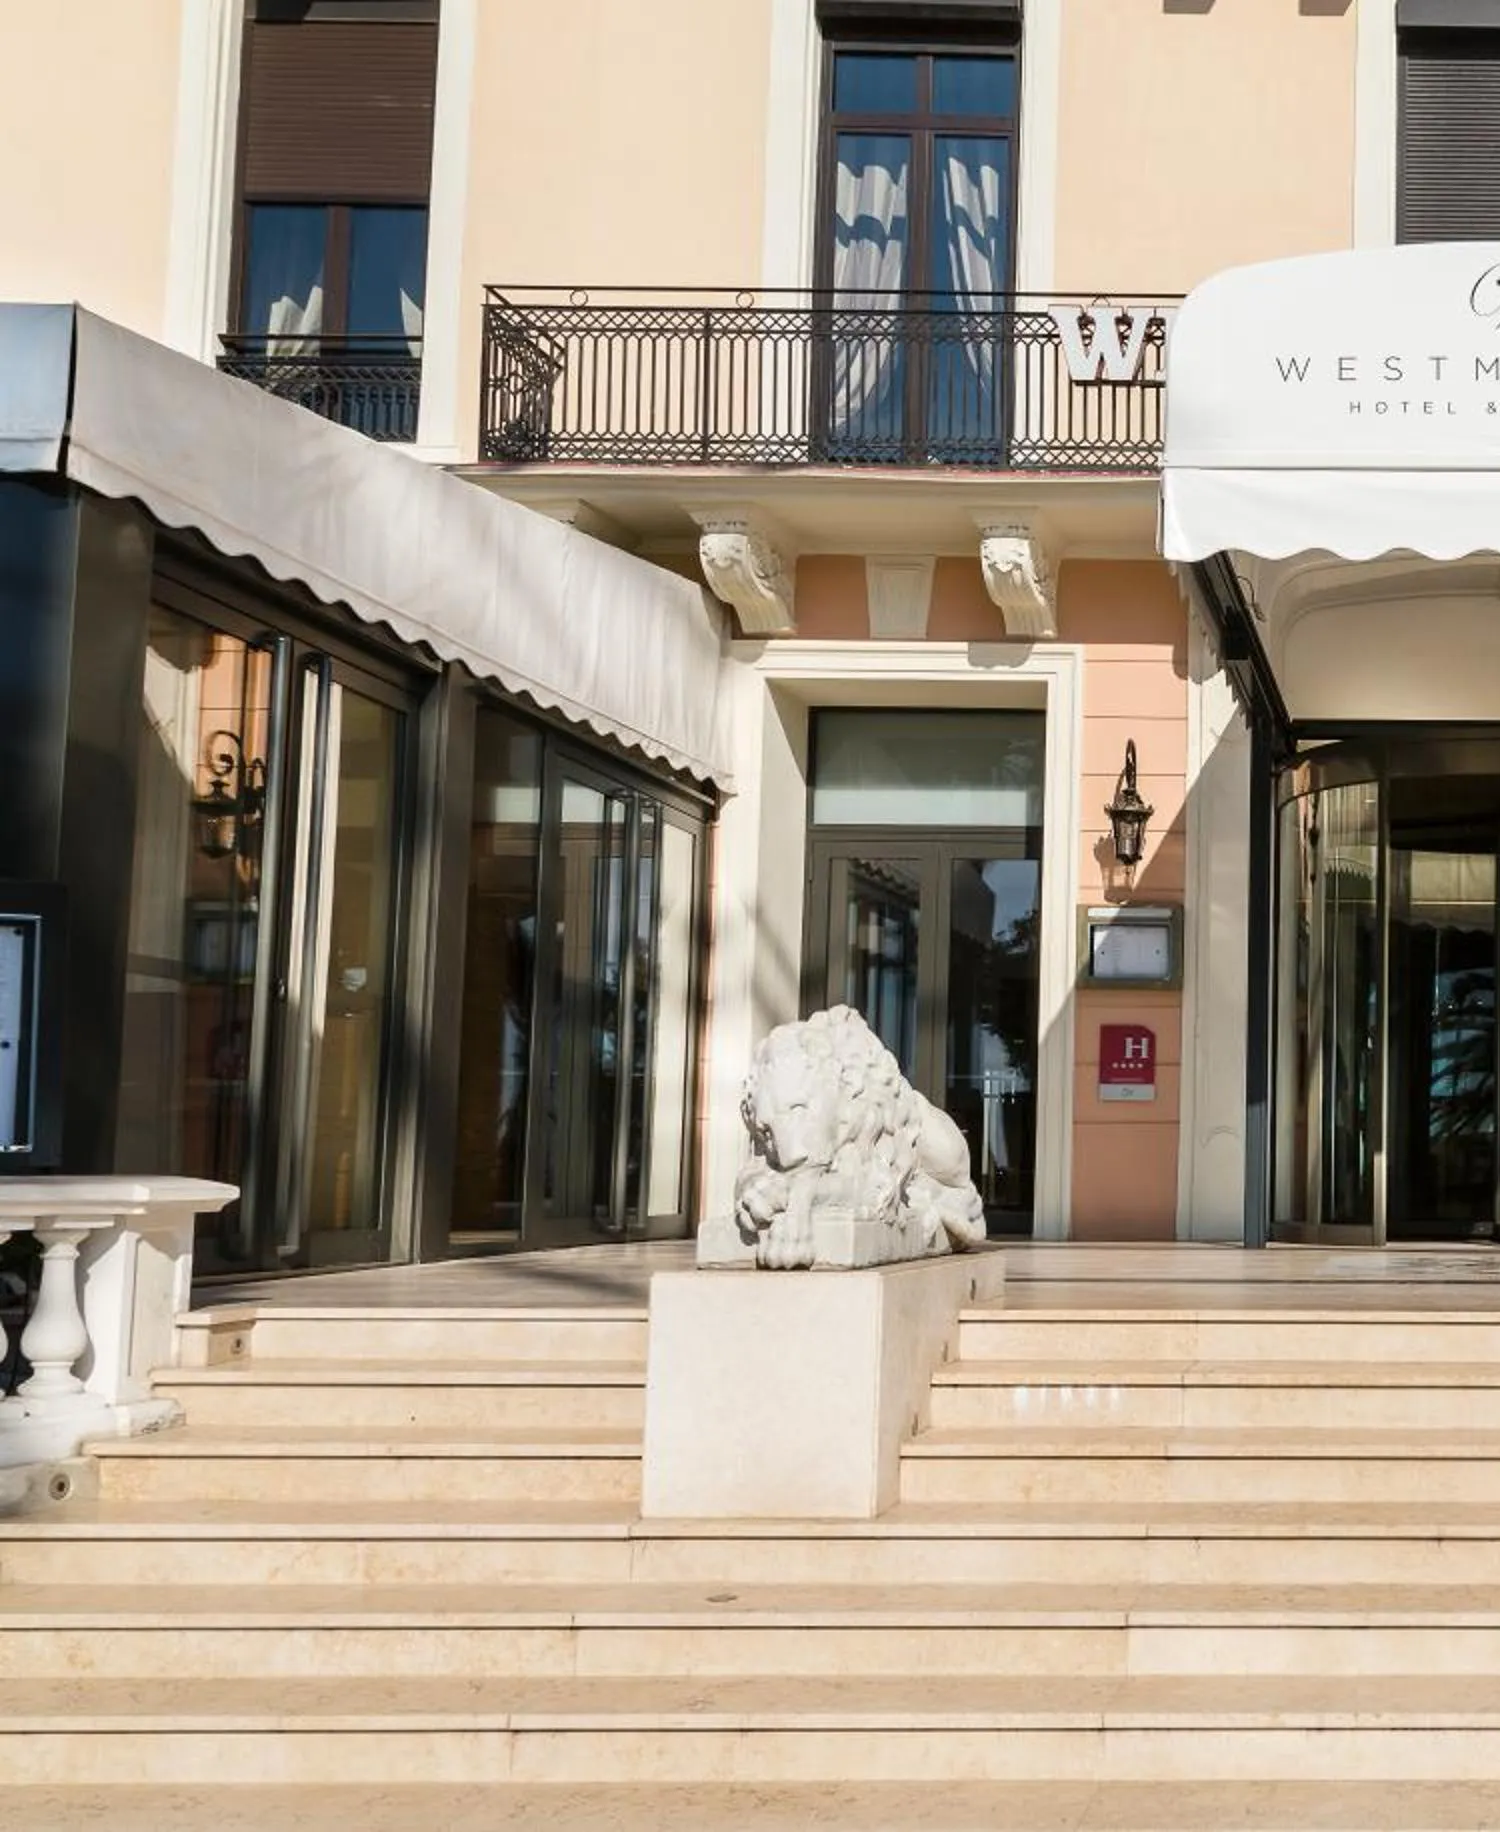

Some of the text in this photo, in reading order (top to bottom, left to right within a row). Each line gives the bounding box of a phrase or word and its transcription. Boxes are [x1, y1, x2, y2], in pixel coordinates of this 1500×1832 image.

[1349, 401, 1457, 415] HOTEL
[1485, 401, 1498, 415] &
[1124, 1037, 1148, 1059] H
